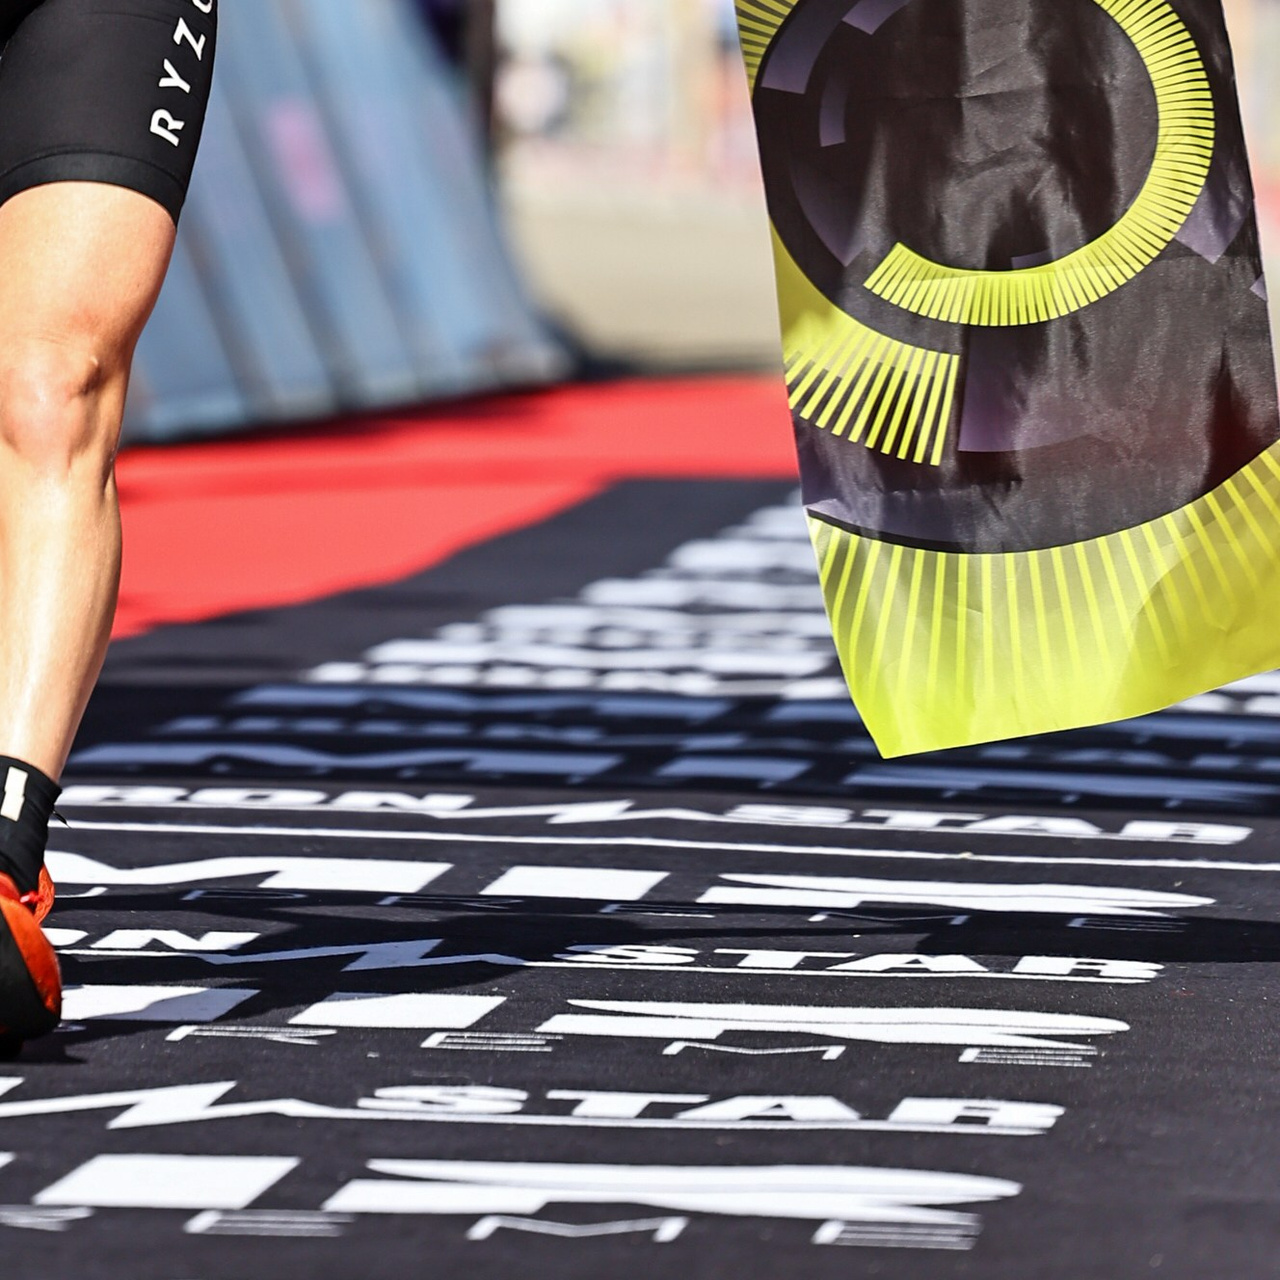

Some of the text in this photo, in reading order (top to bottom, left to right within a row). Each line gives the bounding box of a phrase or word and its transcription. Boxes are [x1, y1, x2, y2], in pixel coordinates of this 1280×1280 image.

[57, 784, 477, 812] RON
[549, 944, 1165, 980] STAR
[356, 1085, 1067, 1130] STAR
